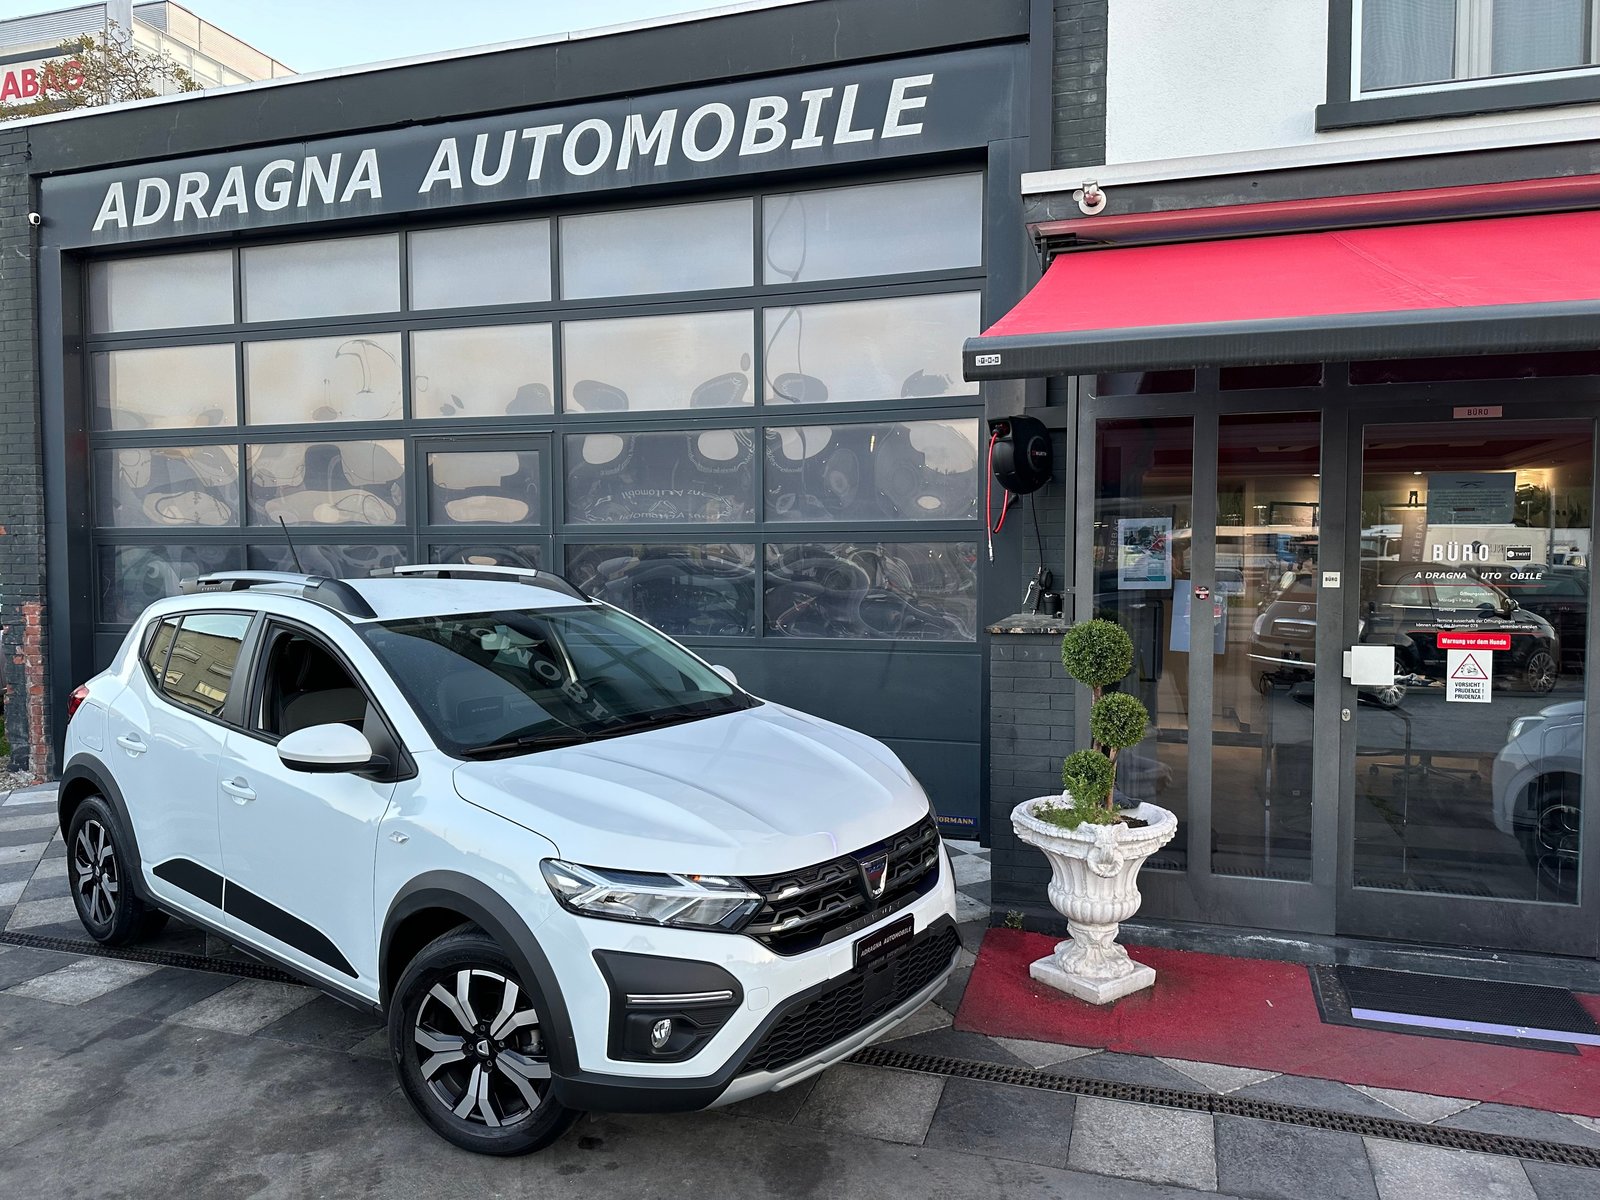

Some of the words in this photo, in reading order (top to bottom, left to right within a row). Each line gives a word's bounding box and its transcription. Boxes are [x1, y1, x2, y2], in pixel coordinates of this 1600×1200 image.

[92, 148, 383, 232] ADRAGNA
[418, 73, 934, 194] AUTOMOBILE
[1467, 407, 1489, 416] BÜRO
[1432, 541, 1489, 561] BÜRO
[1441, 637, 1466, 645] Warnung
[1489, 638, 1506, 646] Hunde
[882, 925, 912, 945] AUTOMOBILE
